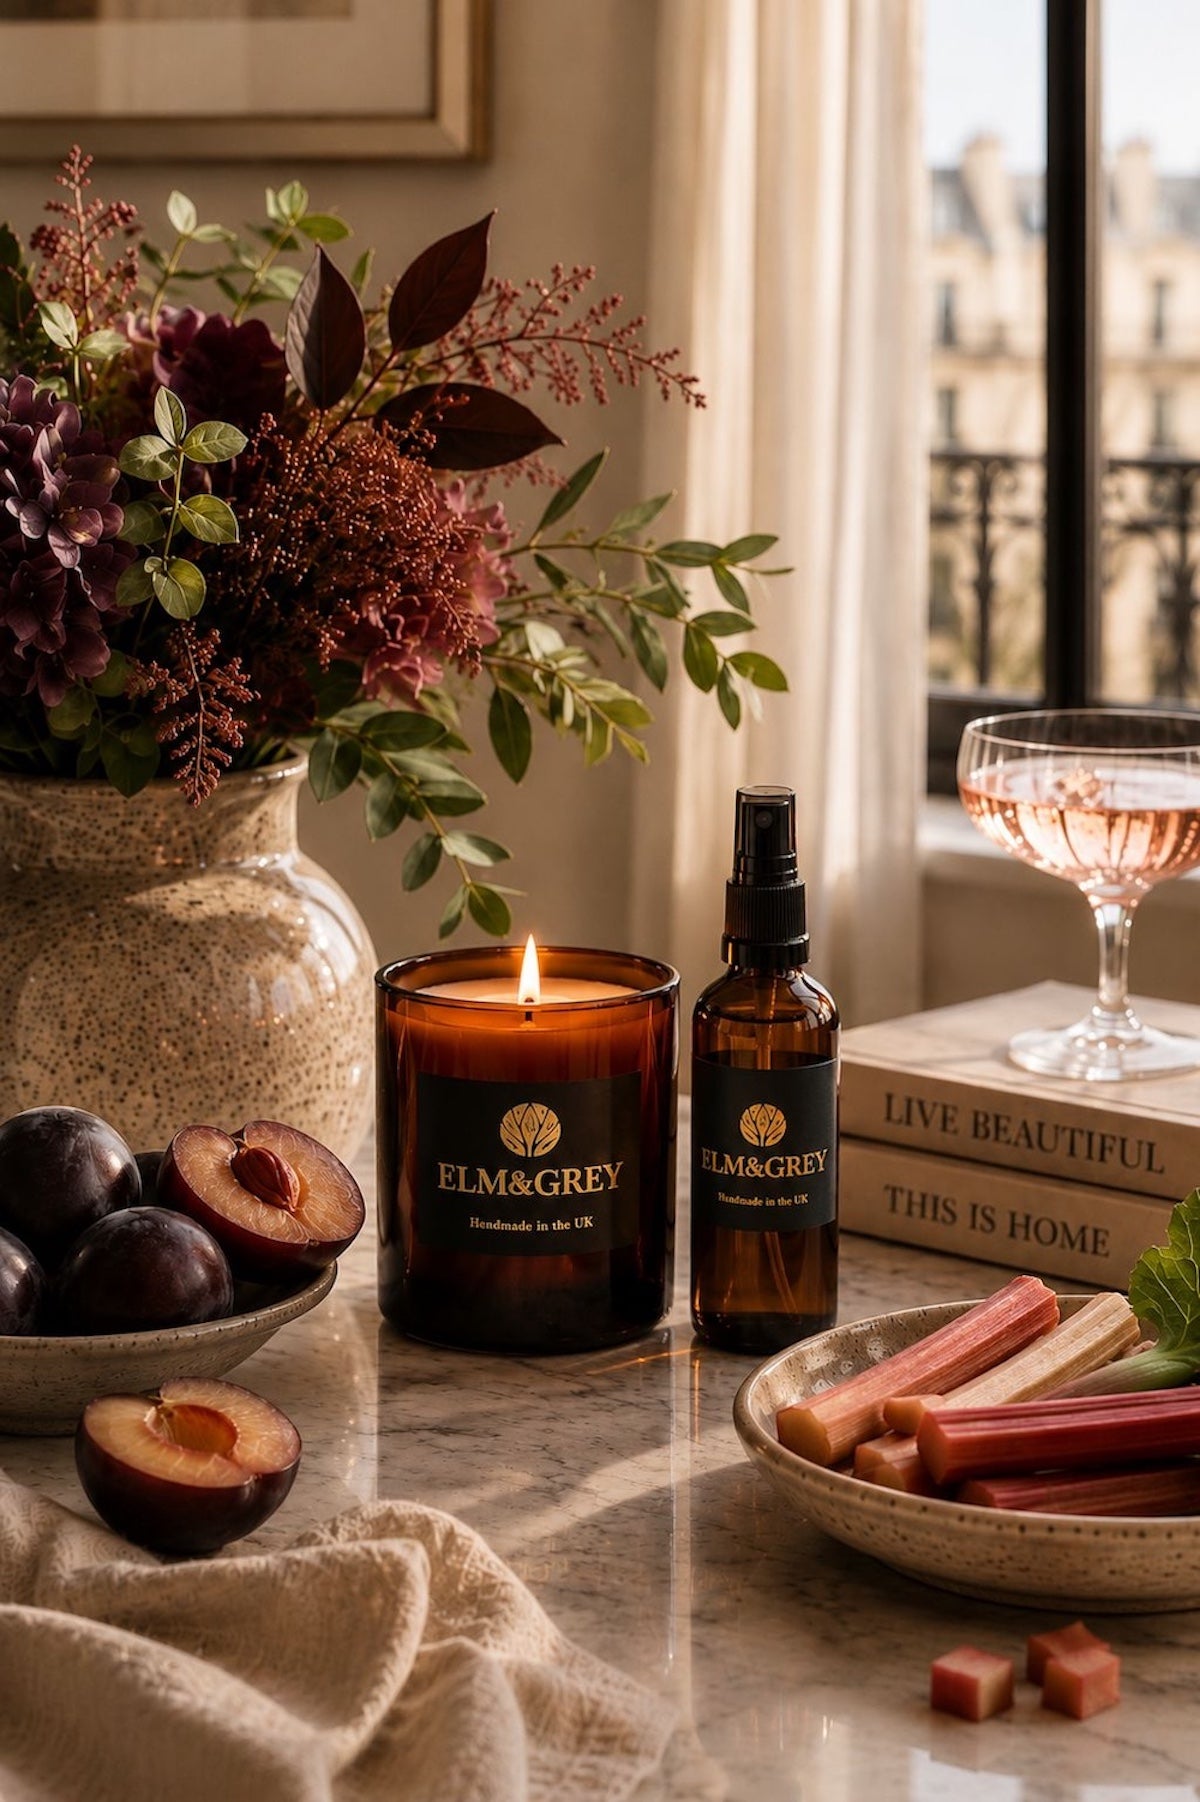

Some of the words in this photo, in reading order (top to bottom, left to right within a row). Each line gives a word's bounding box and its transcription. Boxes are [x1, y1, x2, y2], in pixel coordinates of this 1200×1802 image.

[884, 1092, 958, 1136] LIVE
[971, 1109, 1165, 1174] BEAUTIFUL
[437, 1161, 624, 1197] ELM&GREY
[701, 1147, 829, 1178] ELM&GREY
[765, 1197, 775, 1206] in
[777, 1196, 792, 1206] the
[794, 1193, 809, 1205] UK
[536, 1220, 549, 1231] in
[552, 1218, 571, 1231] the
[574, 1216, 594, 1229] UK
[884, 1184, 957, 1226] THIS
[969, 1202, 996, 1234] IS
[1009, 1211, 1110, 1257] HOME
